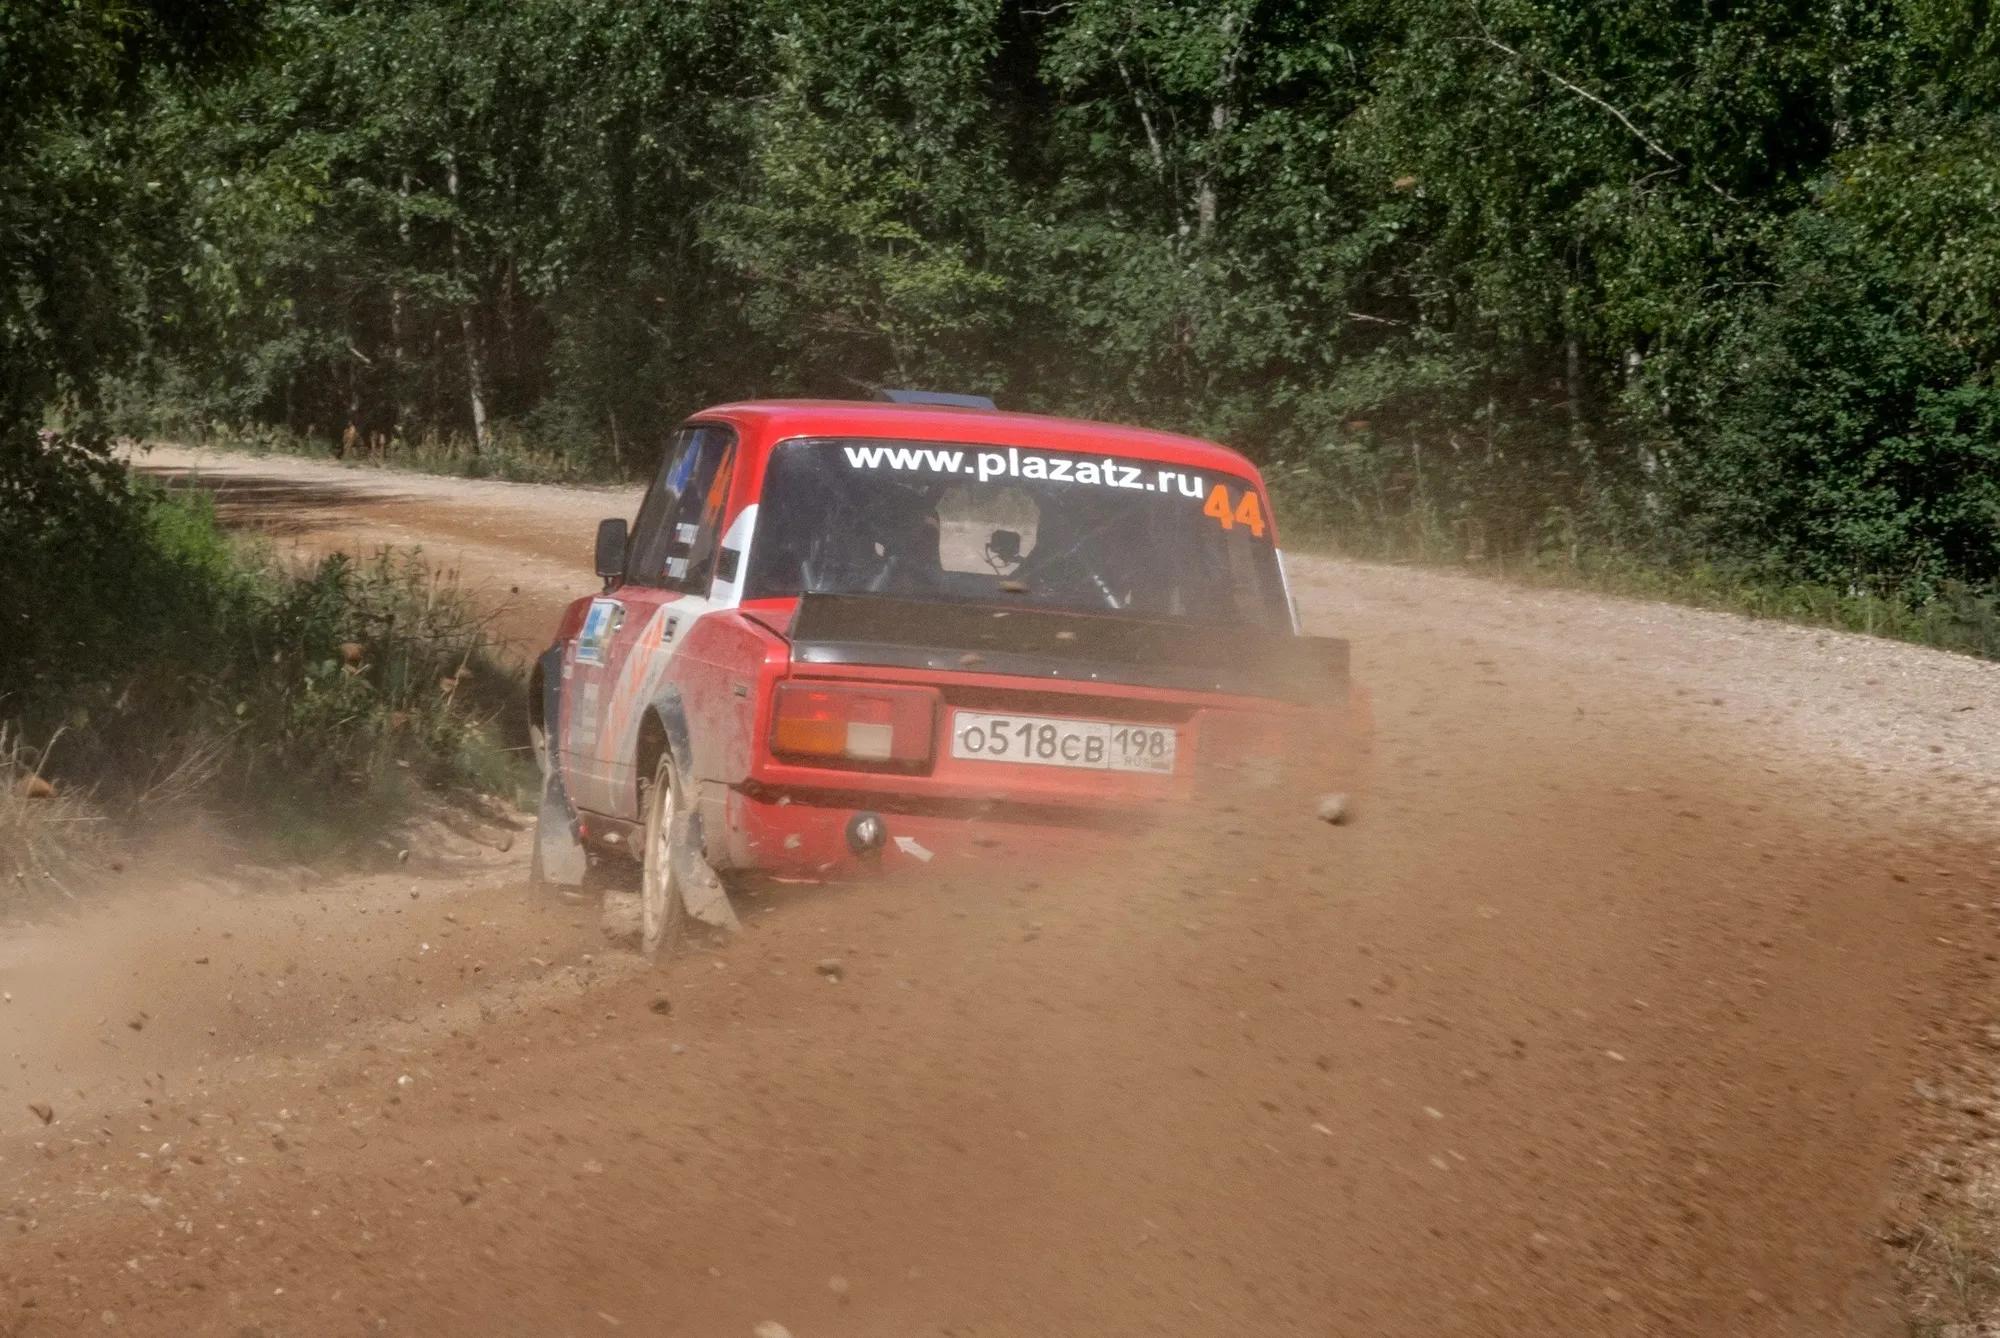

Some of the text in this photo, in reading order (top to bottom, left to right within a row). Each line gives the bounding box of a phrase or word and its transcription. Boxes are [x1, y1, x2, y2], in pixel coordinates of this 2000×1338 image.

[844, 446, 1203, 499] www.plazatz.ru
[1204, 484, 1264, 537] 44
[1114, 728, 1165, 758] 198
